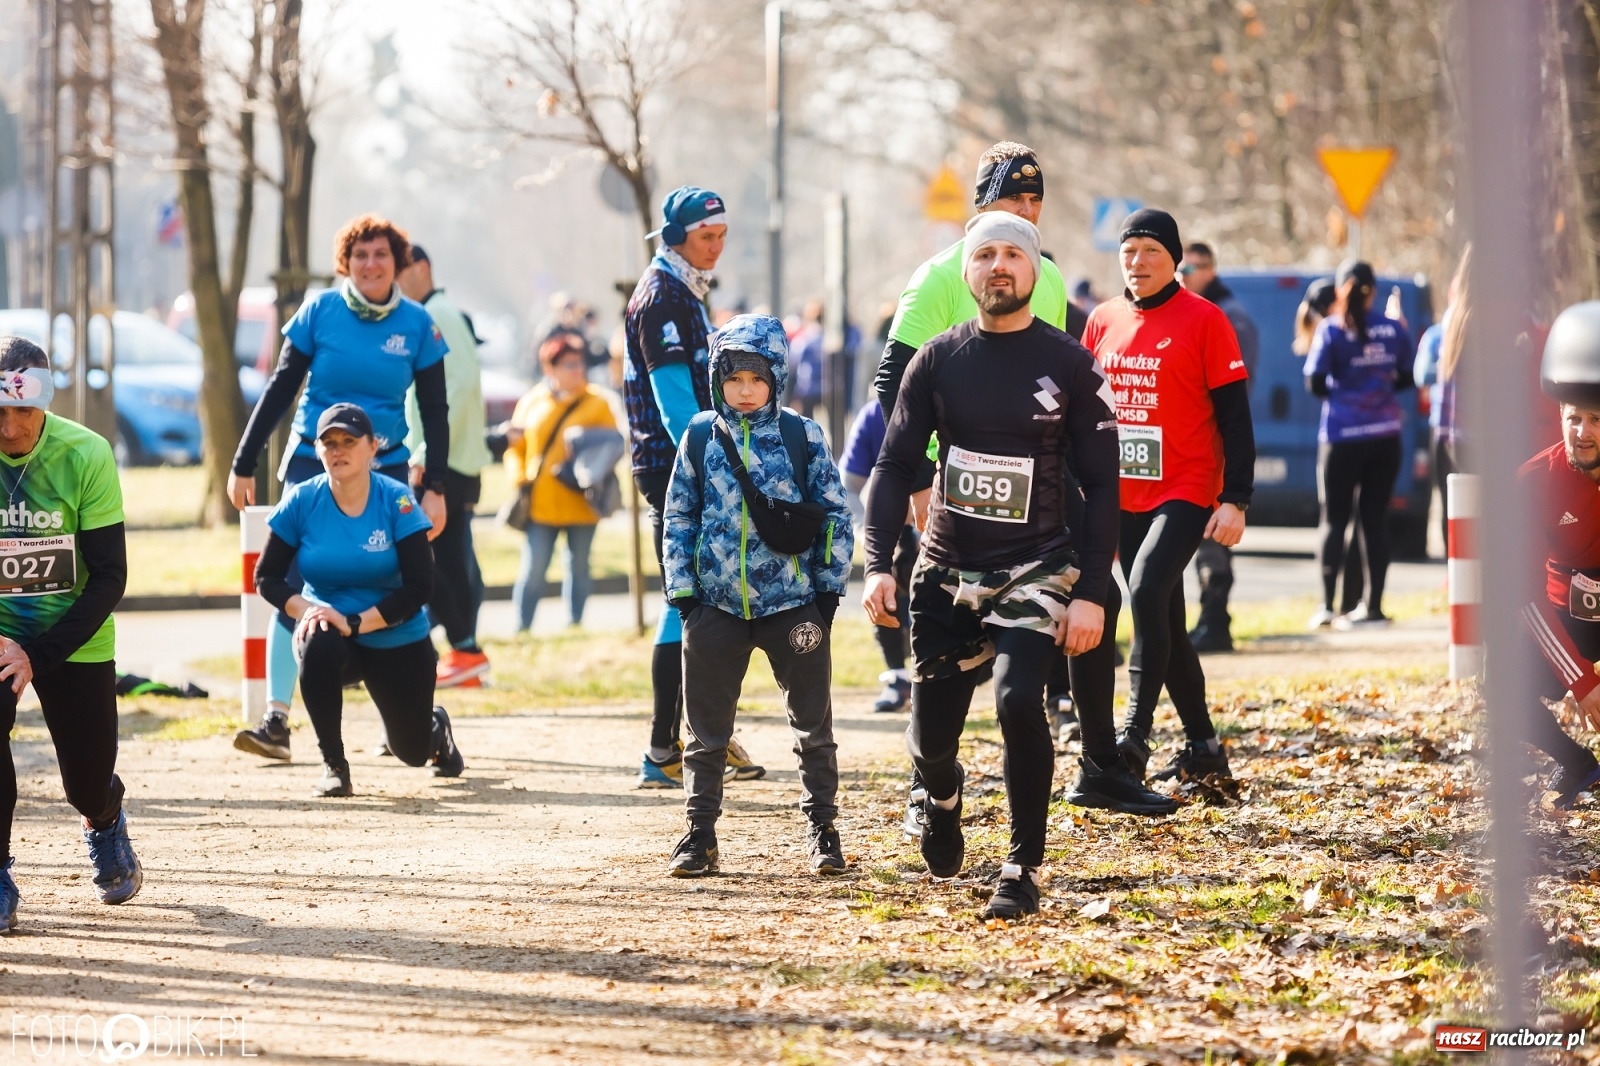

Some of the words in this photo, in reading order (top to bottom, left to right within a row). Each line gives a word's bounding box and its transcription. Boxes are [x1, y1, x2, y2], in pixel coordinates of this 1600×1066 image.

[1120, 353, 1161, 371] MOŻESZ
[1106, 372, 1157, 388] RATOWAĆ
[1131, 389, 1159, 406] ŻYCIE
[961, 453, 976, 462] BIEG
[978, 456, 1022, 468] Twardziela
[958, 472, 1012, 502] 059
[18, 538, 63, 547] Twardziela
[2, 556, 56, 579] 027
[1582, 593, 1600, 609] 0
